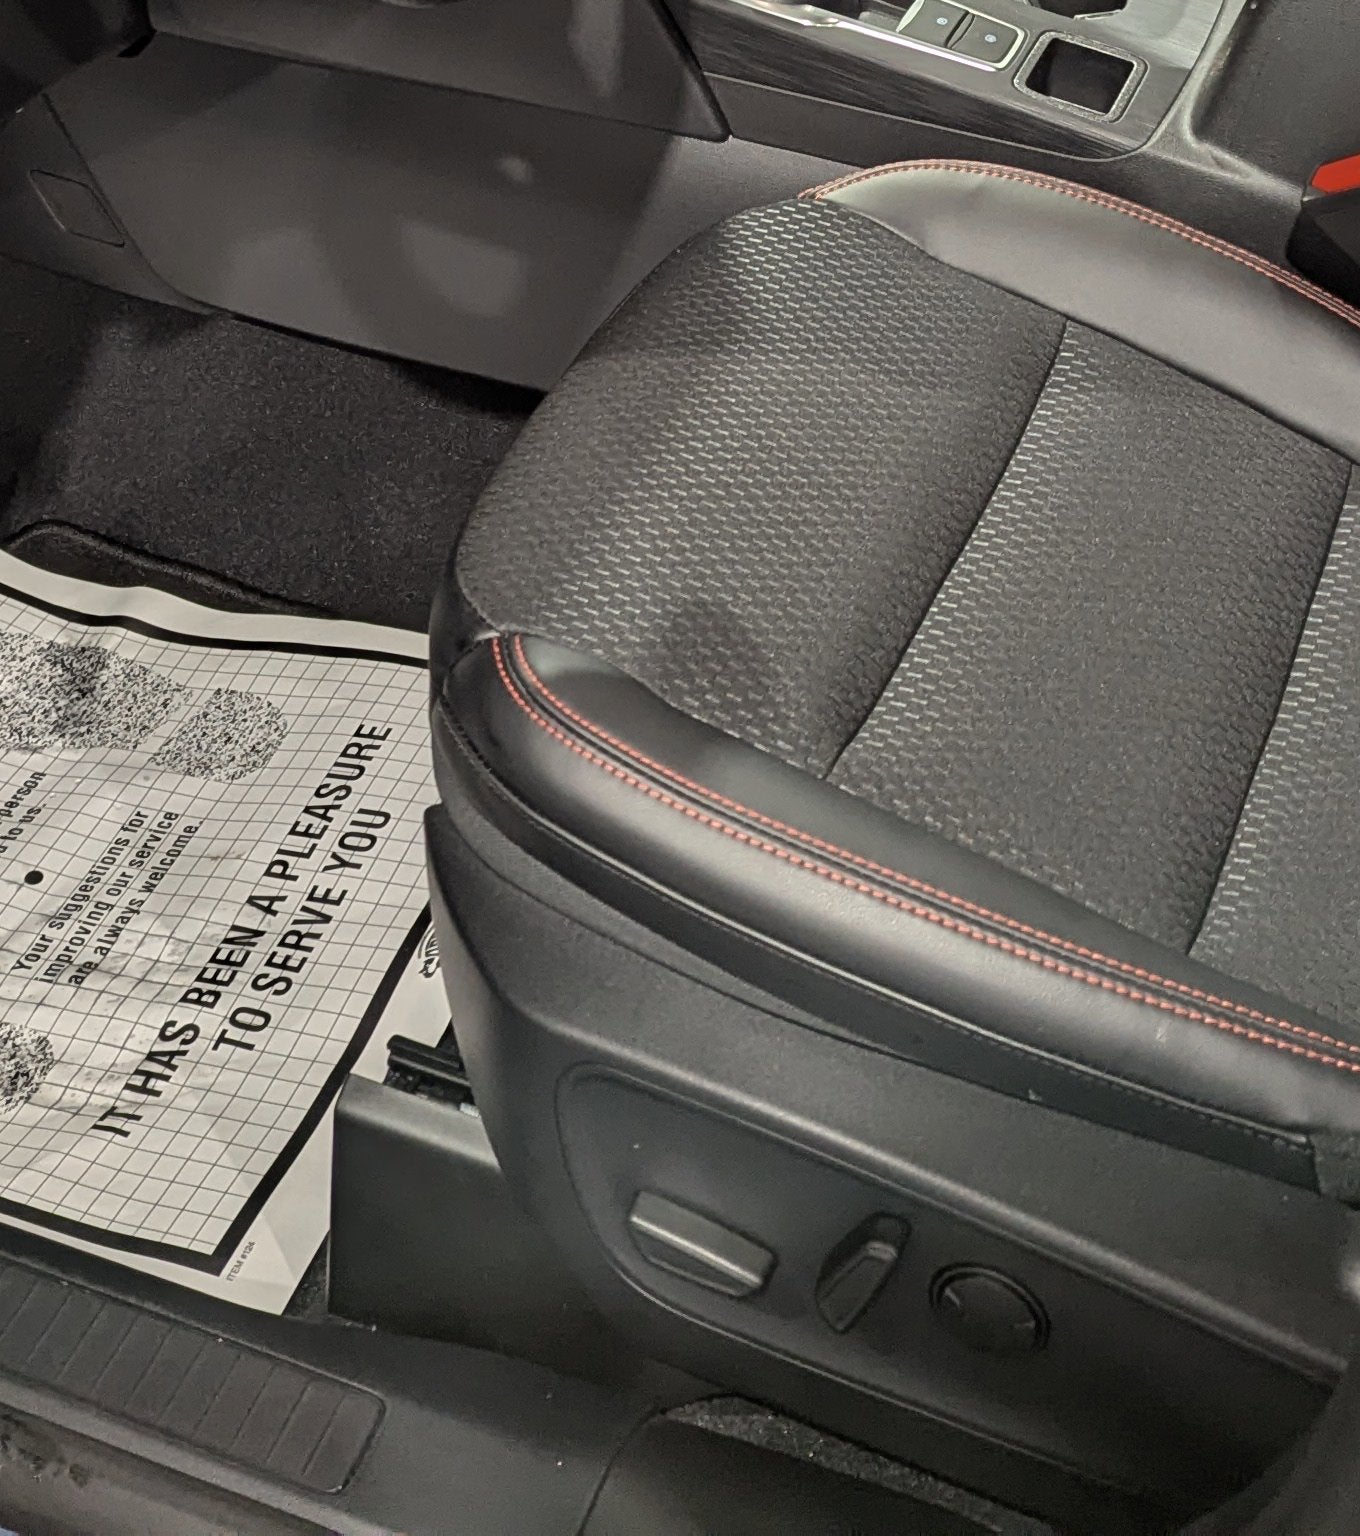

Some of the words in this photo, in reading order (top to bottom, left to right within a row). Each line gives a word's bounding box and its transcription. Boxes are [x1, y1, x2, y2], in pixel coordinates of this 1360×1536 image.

[0, 827, 24, 841] to
[18, 803, 48, 825] us.
[262, 722, 394, 882] PLEASURE
[11, 934, 54, 972] Your
[48, 837, 131, 930] suggestions
[120, 810, 149, 833] for
[34, 900, 115, 984] improving
[105, 871, 134, 897] our
[128, 811, 180, 868] service
[68, 961, 99, 986] are
[93, 897, 146, 957] always
[138, 820, 205, 893] welcome.
[211, 1006, 272, 1053] TO
[251, 884, 350, 996] SERVE
[323, 807, 393, 871] YOU
[244, 894, 290, 917] A
[178, 924, 268, 1010] BEEN
[122, 1018, 201, 1098] HAS
[90, 1106, 143, 1139] IT
[226, 1260, 244, 1282] ITEM
